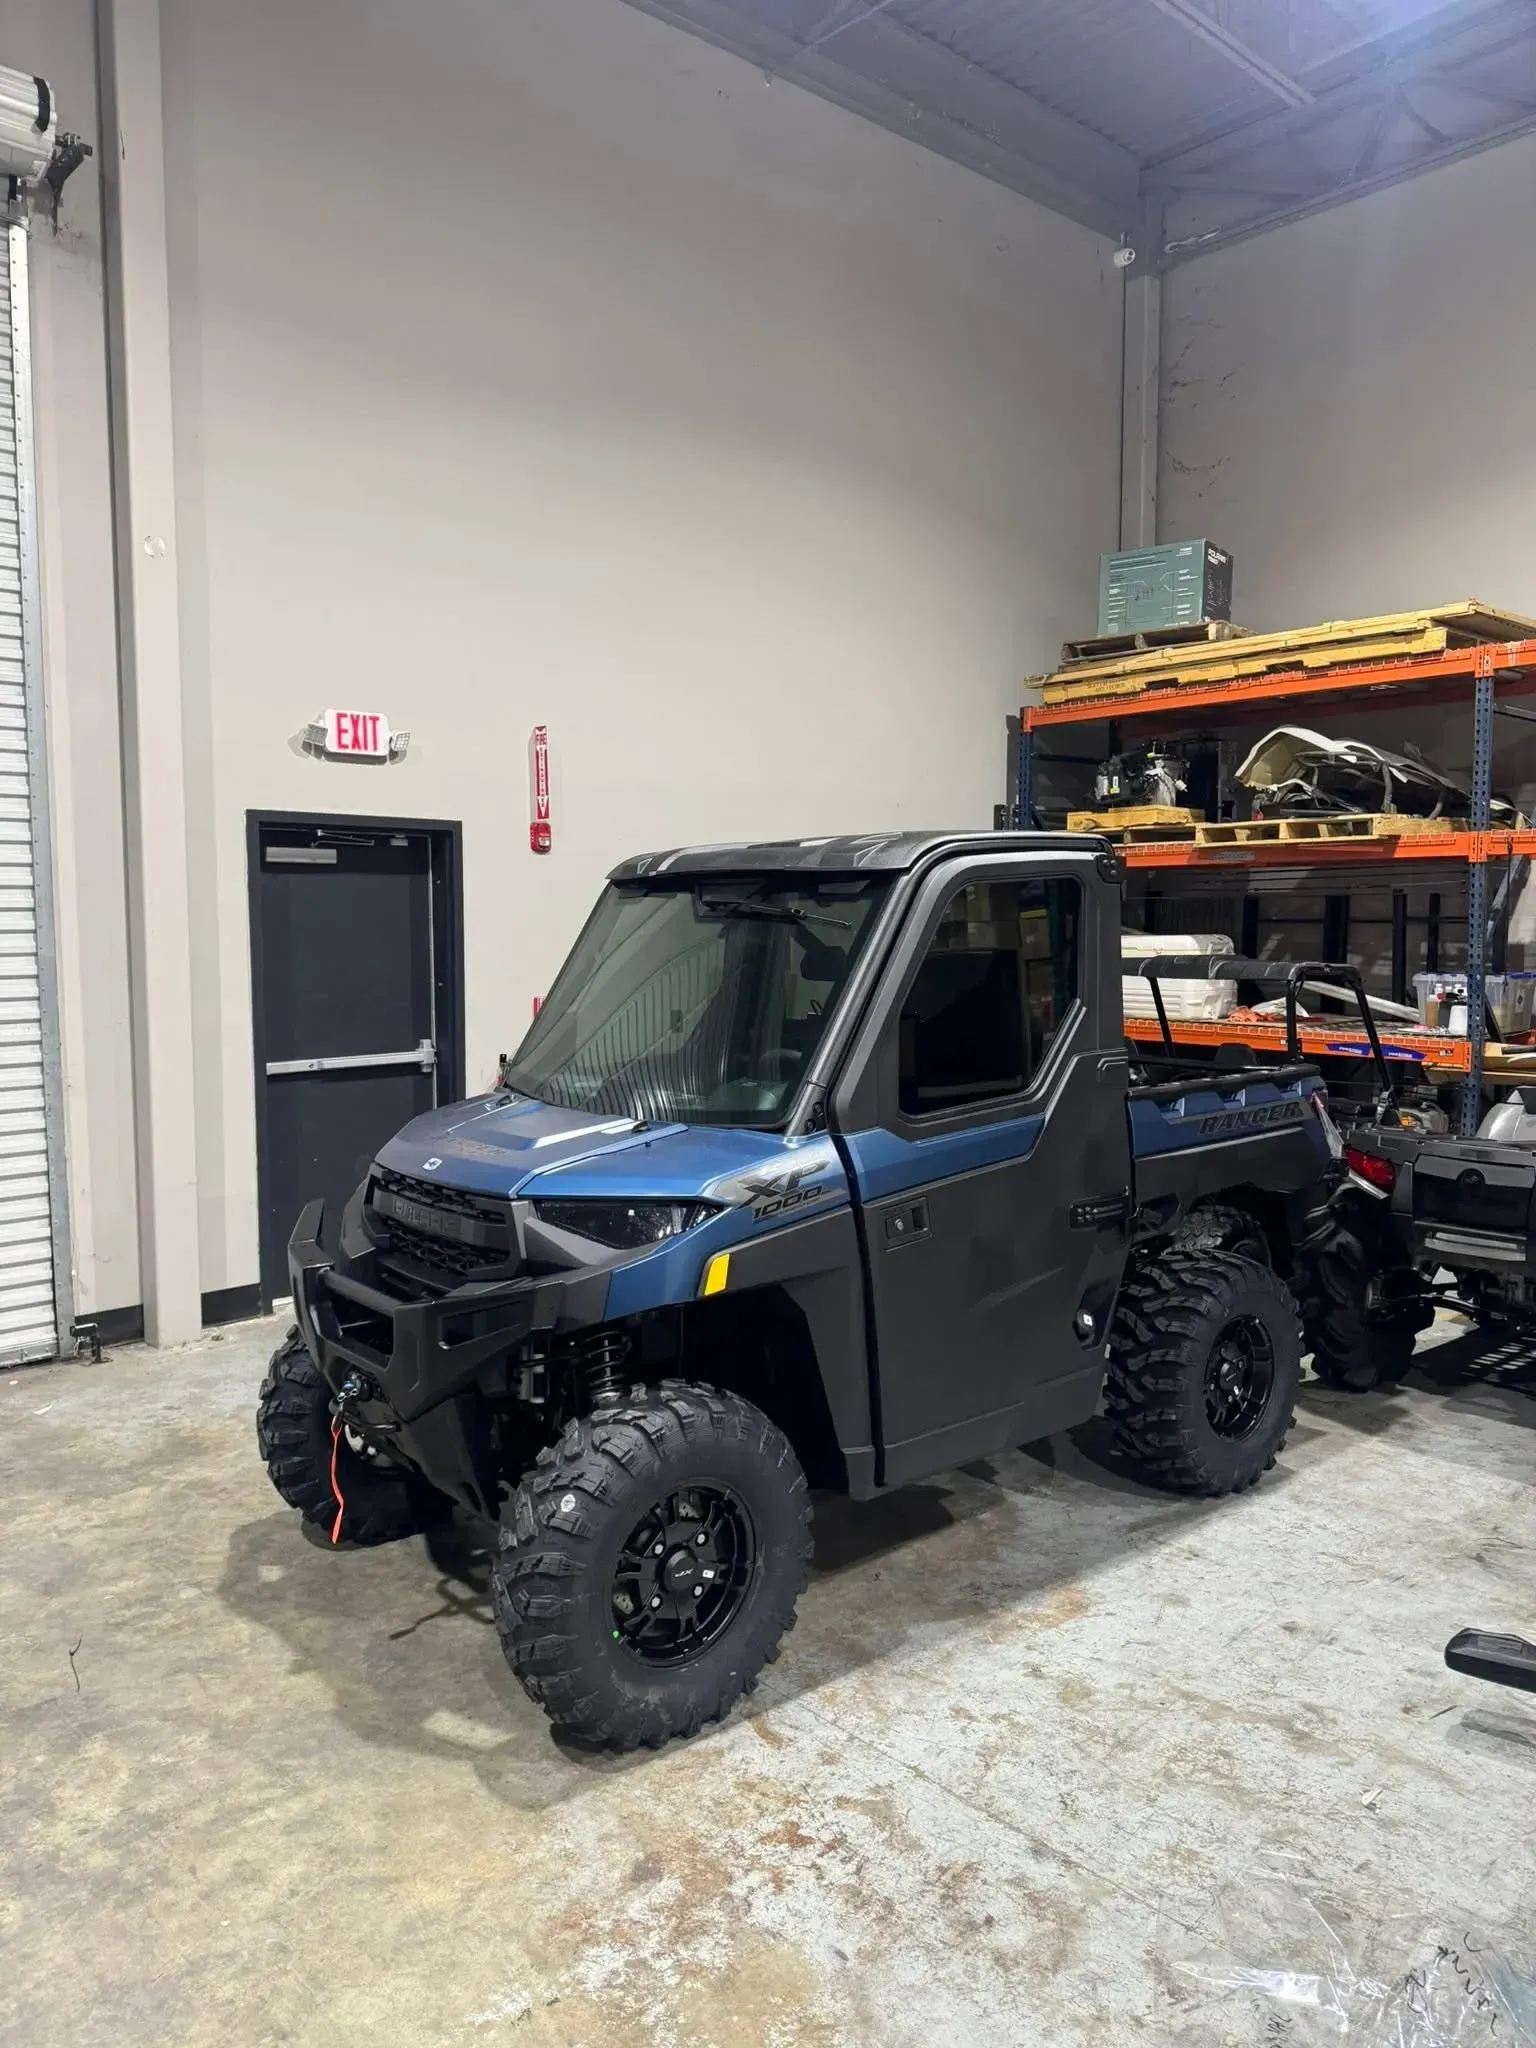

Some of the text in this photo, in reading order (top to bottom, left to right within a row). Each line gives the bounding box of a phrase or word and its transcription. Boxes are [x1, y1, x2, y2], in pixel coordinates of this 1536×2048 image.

[336, 712, 380, 752] EXIT
[1198, 1101, 1305, 1135] RANGER
[735, 1159, 830, 1211] XP
[753, 1185, 823, 1219] 1000
